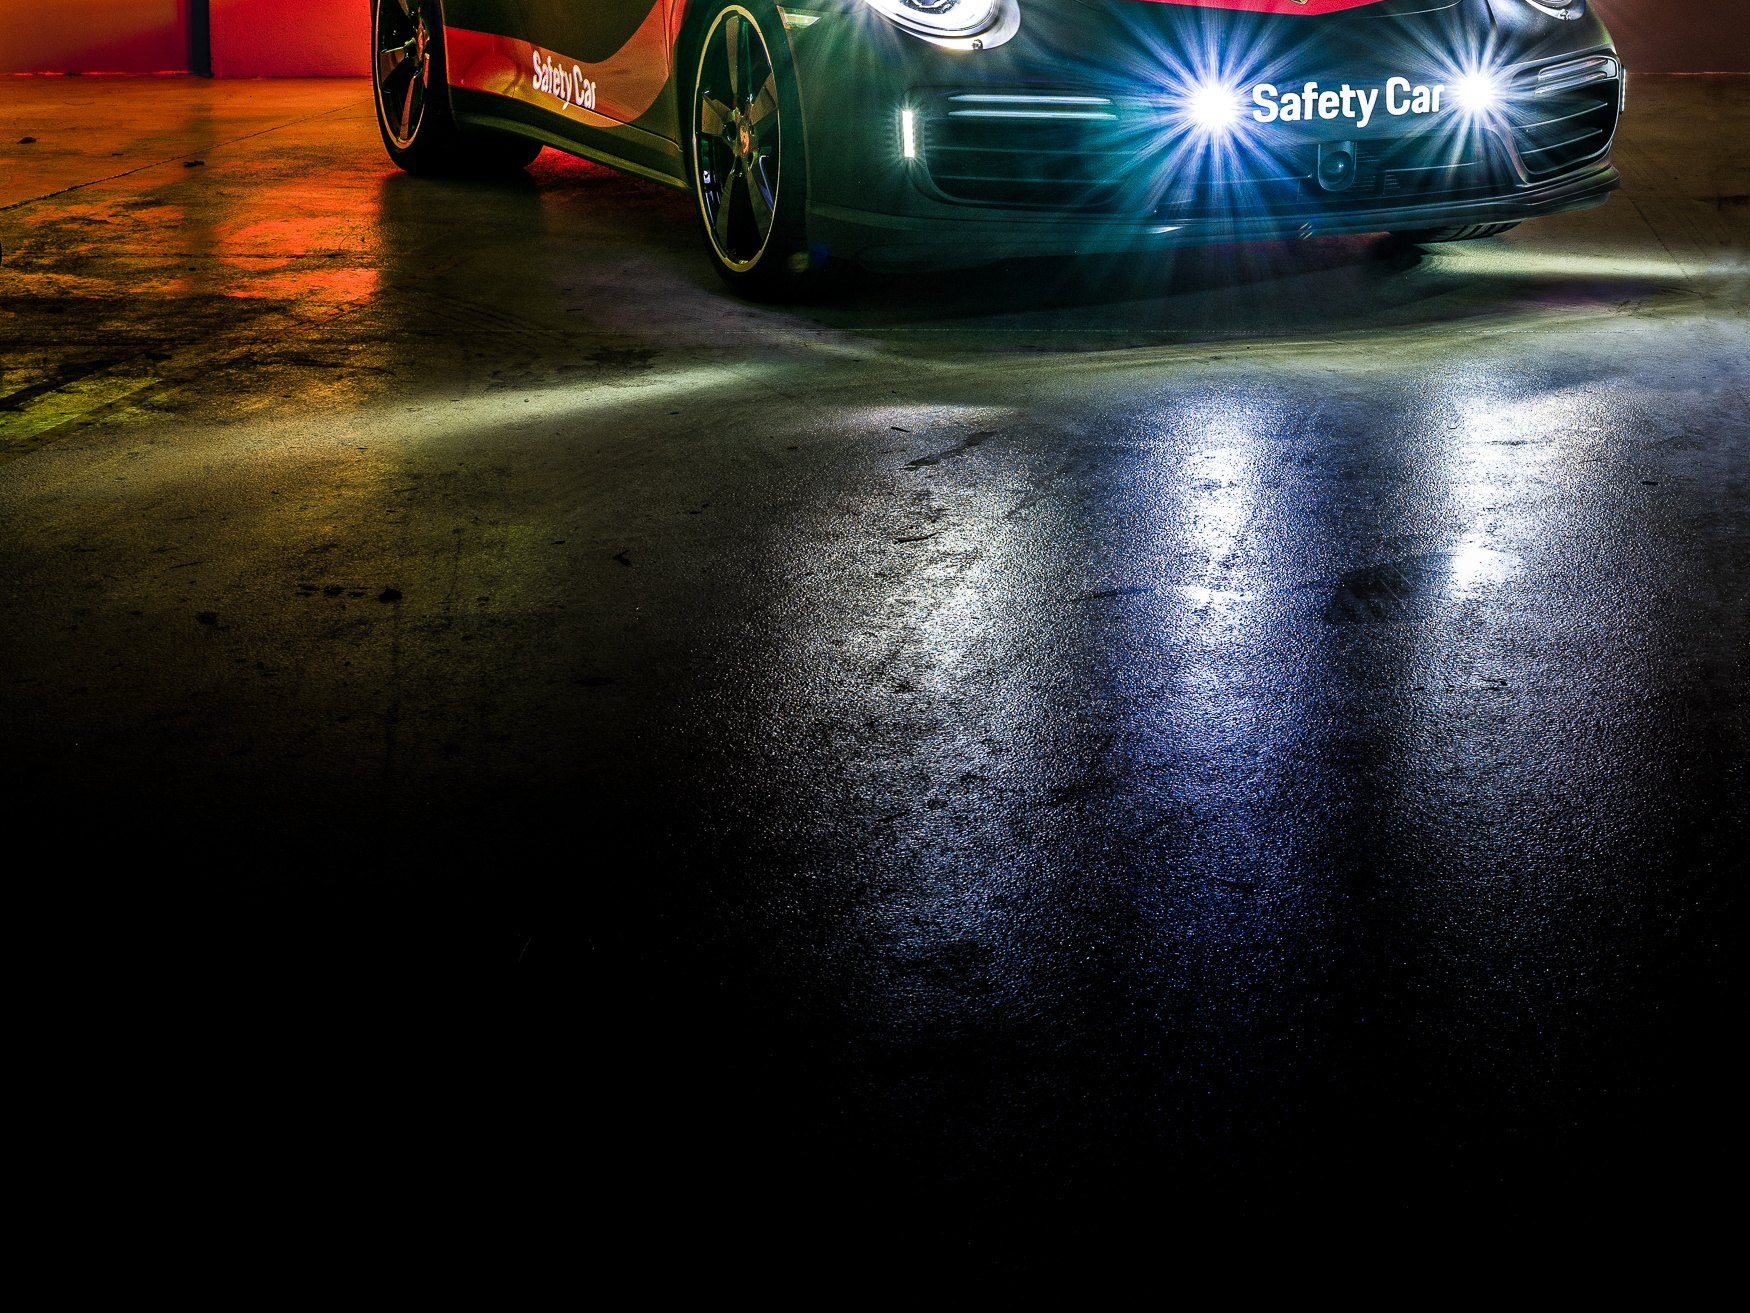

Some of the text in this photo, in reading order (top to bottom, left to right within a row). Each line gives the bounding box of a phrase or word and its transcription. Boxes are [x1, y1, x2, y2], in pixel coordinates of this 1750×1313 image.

[532, 50, 597, 110] Safety Car
[1251, 76, 1446, 129] Safety Car
